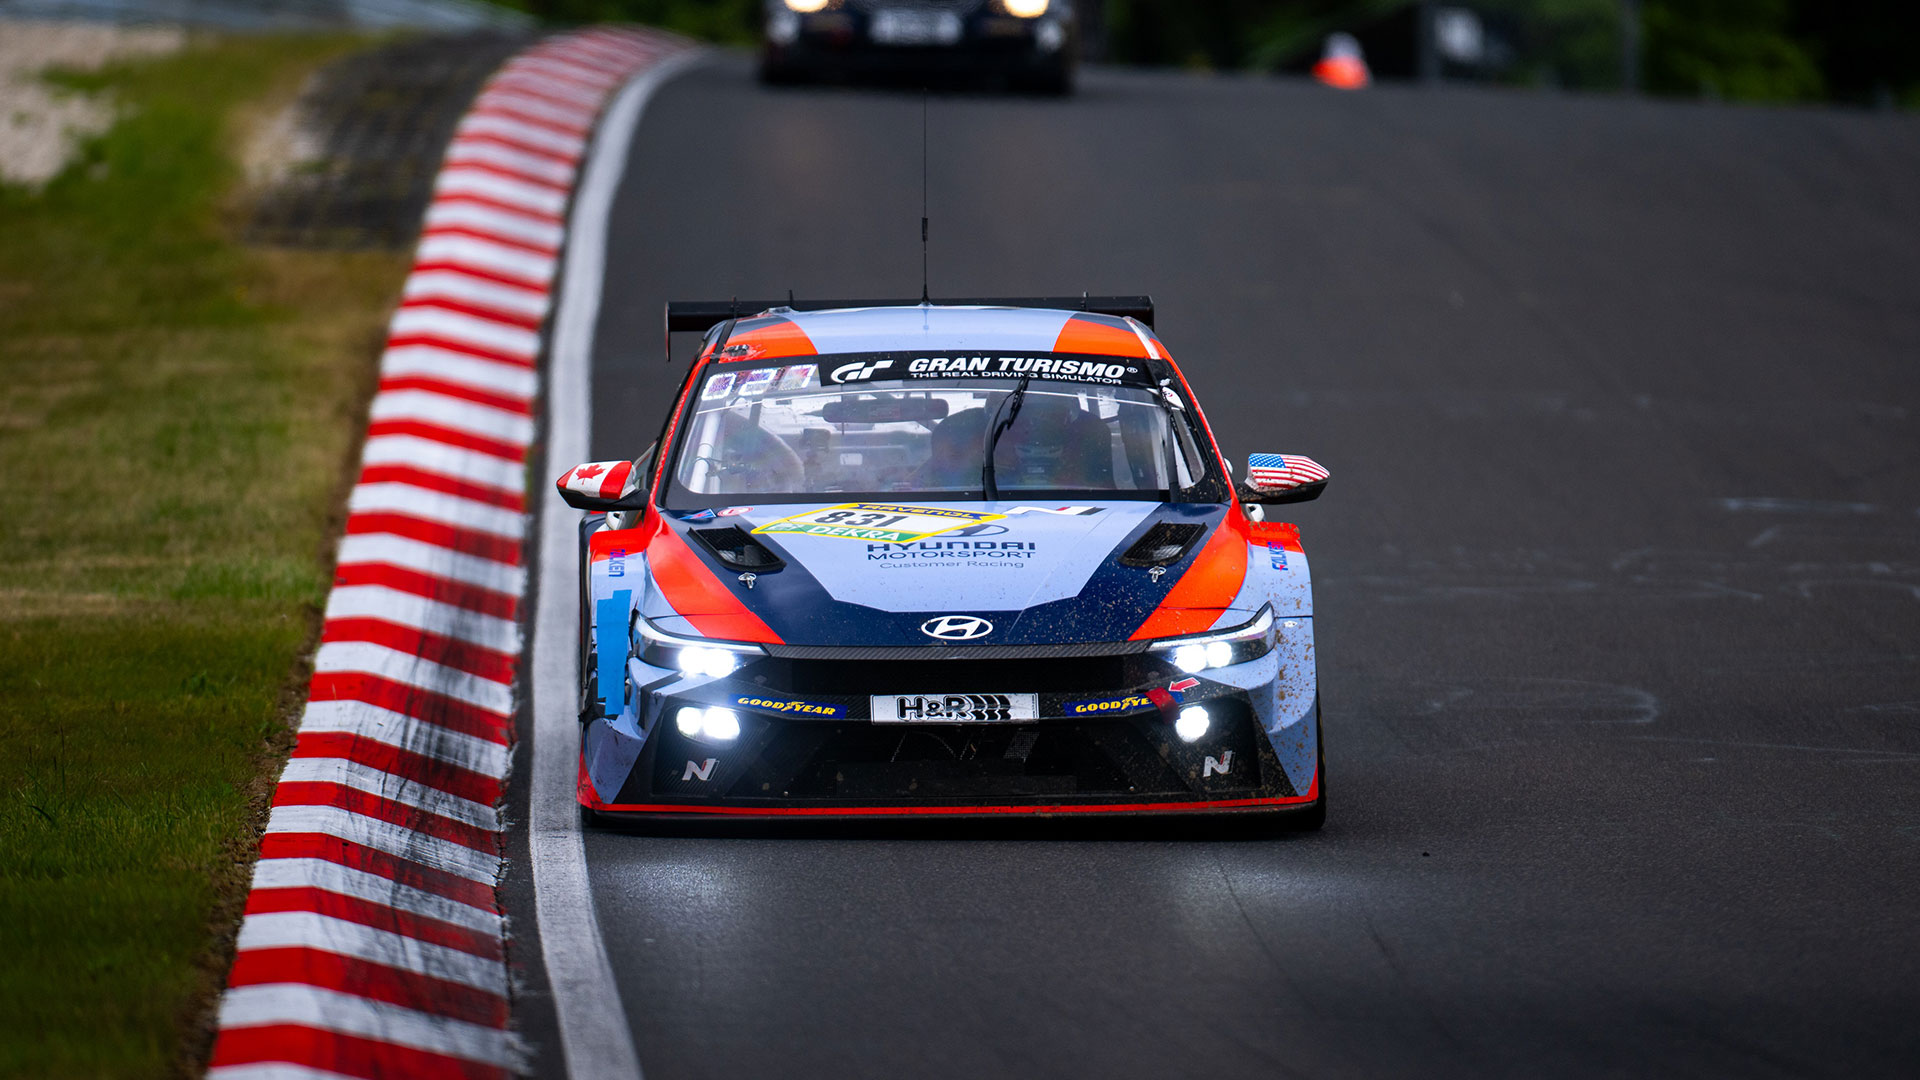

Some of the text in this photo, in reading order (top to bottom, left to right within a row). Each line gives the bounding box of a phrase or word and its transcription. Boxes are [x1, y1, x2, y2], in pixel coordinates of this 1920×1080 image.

[908, 357, 991, 372] GRAN
[1041, 372, 1123, 385] SIMULATOR
[861, 504, 975, 519] RAVENOL
[815, 511, 909, 528] 831
[806, 525, 901, 541] DEKRA
[867, 541, 1036, 552] HYUNDAI
[867, 551, 1036, 561] MOTORSPORT
[879, 560, 1025, 569] Customer Racing
[737, 697, 836, 715] GOODYEAR
[897, 695, 973, 720] H&R
[1075, 696, 1153, 713] GOODYE
